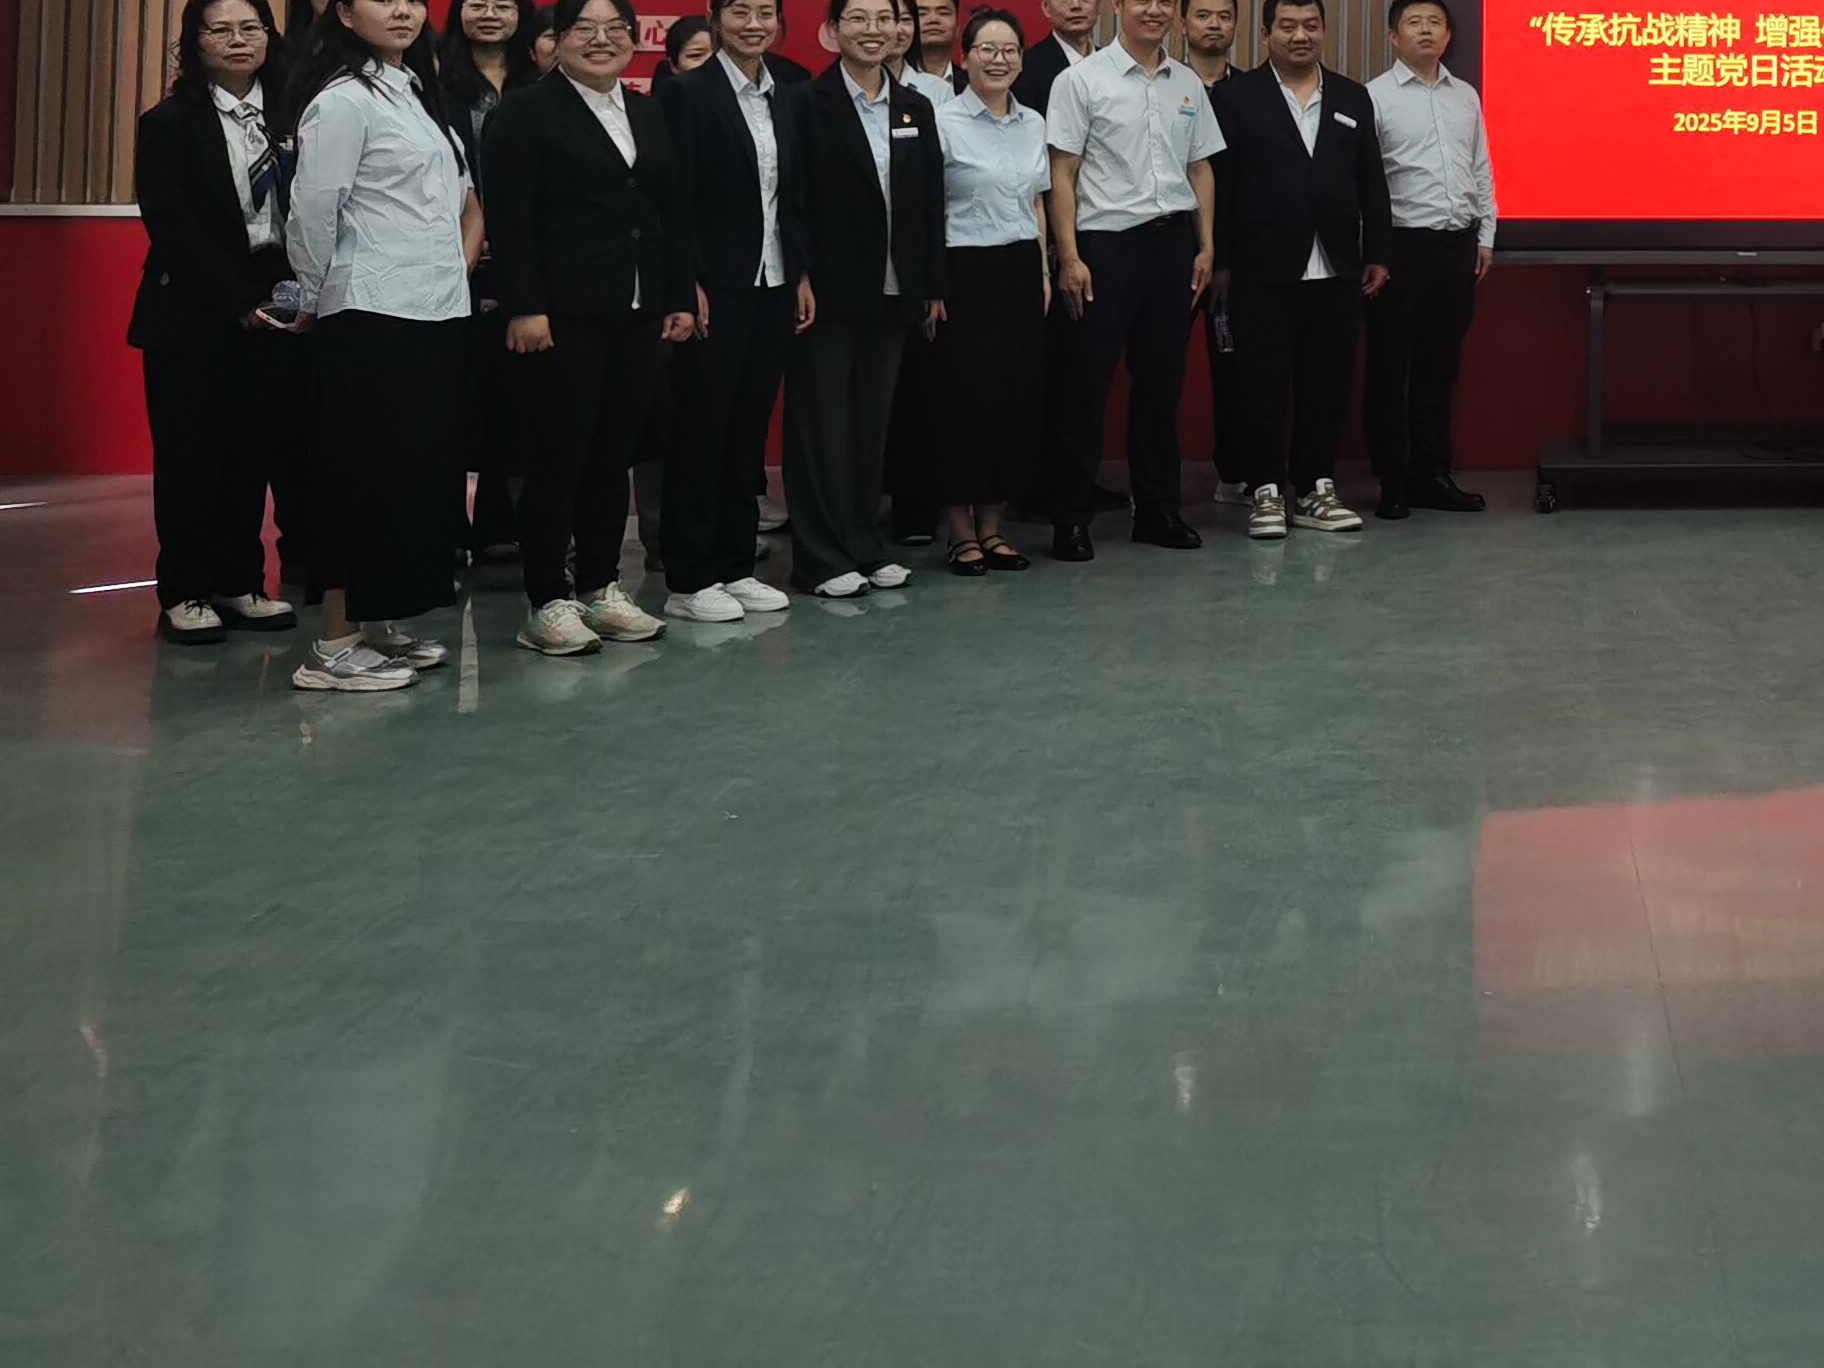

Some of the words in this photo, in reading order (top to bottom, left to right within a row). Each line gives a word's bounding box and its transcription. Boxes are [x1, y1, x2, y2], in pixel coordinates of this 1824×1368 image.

[1529, 12, 1742, 49] “传承抗战精神
[1673, 108, 1818, 136] 2025年9月5日
